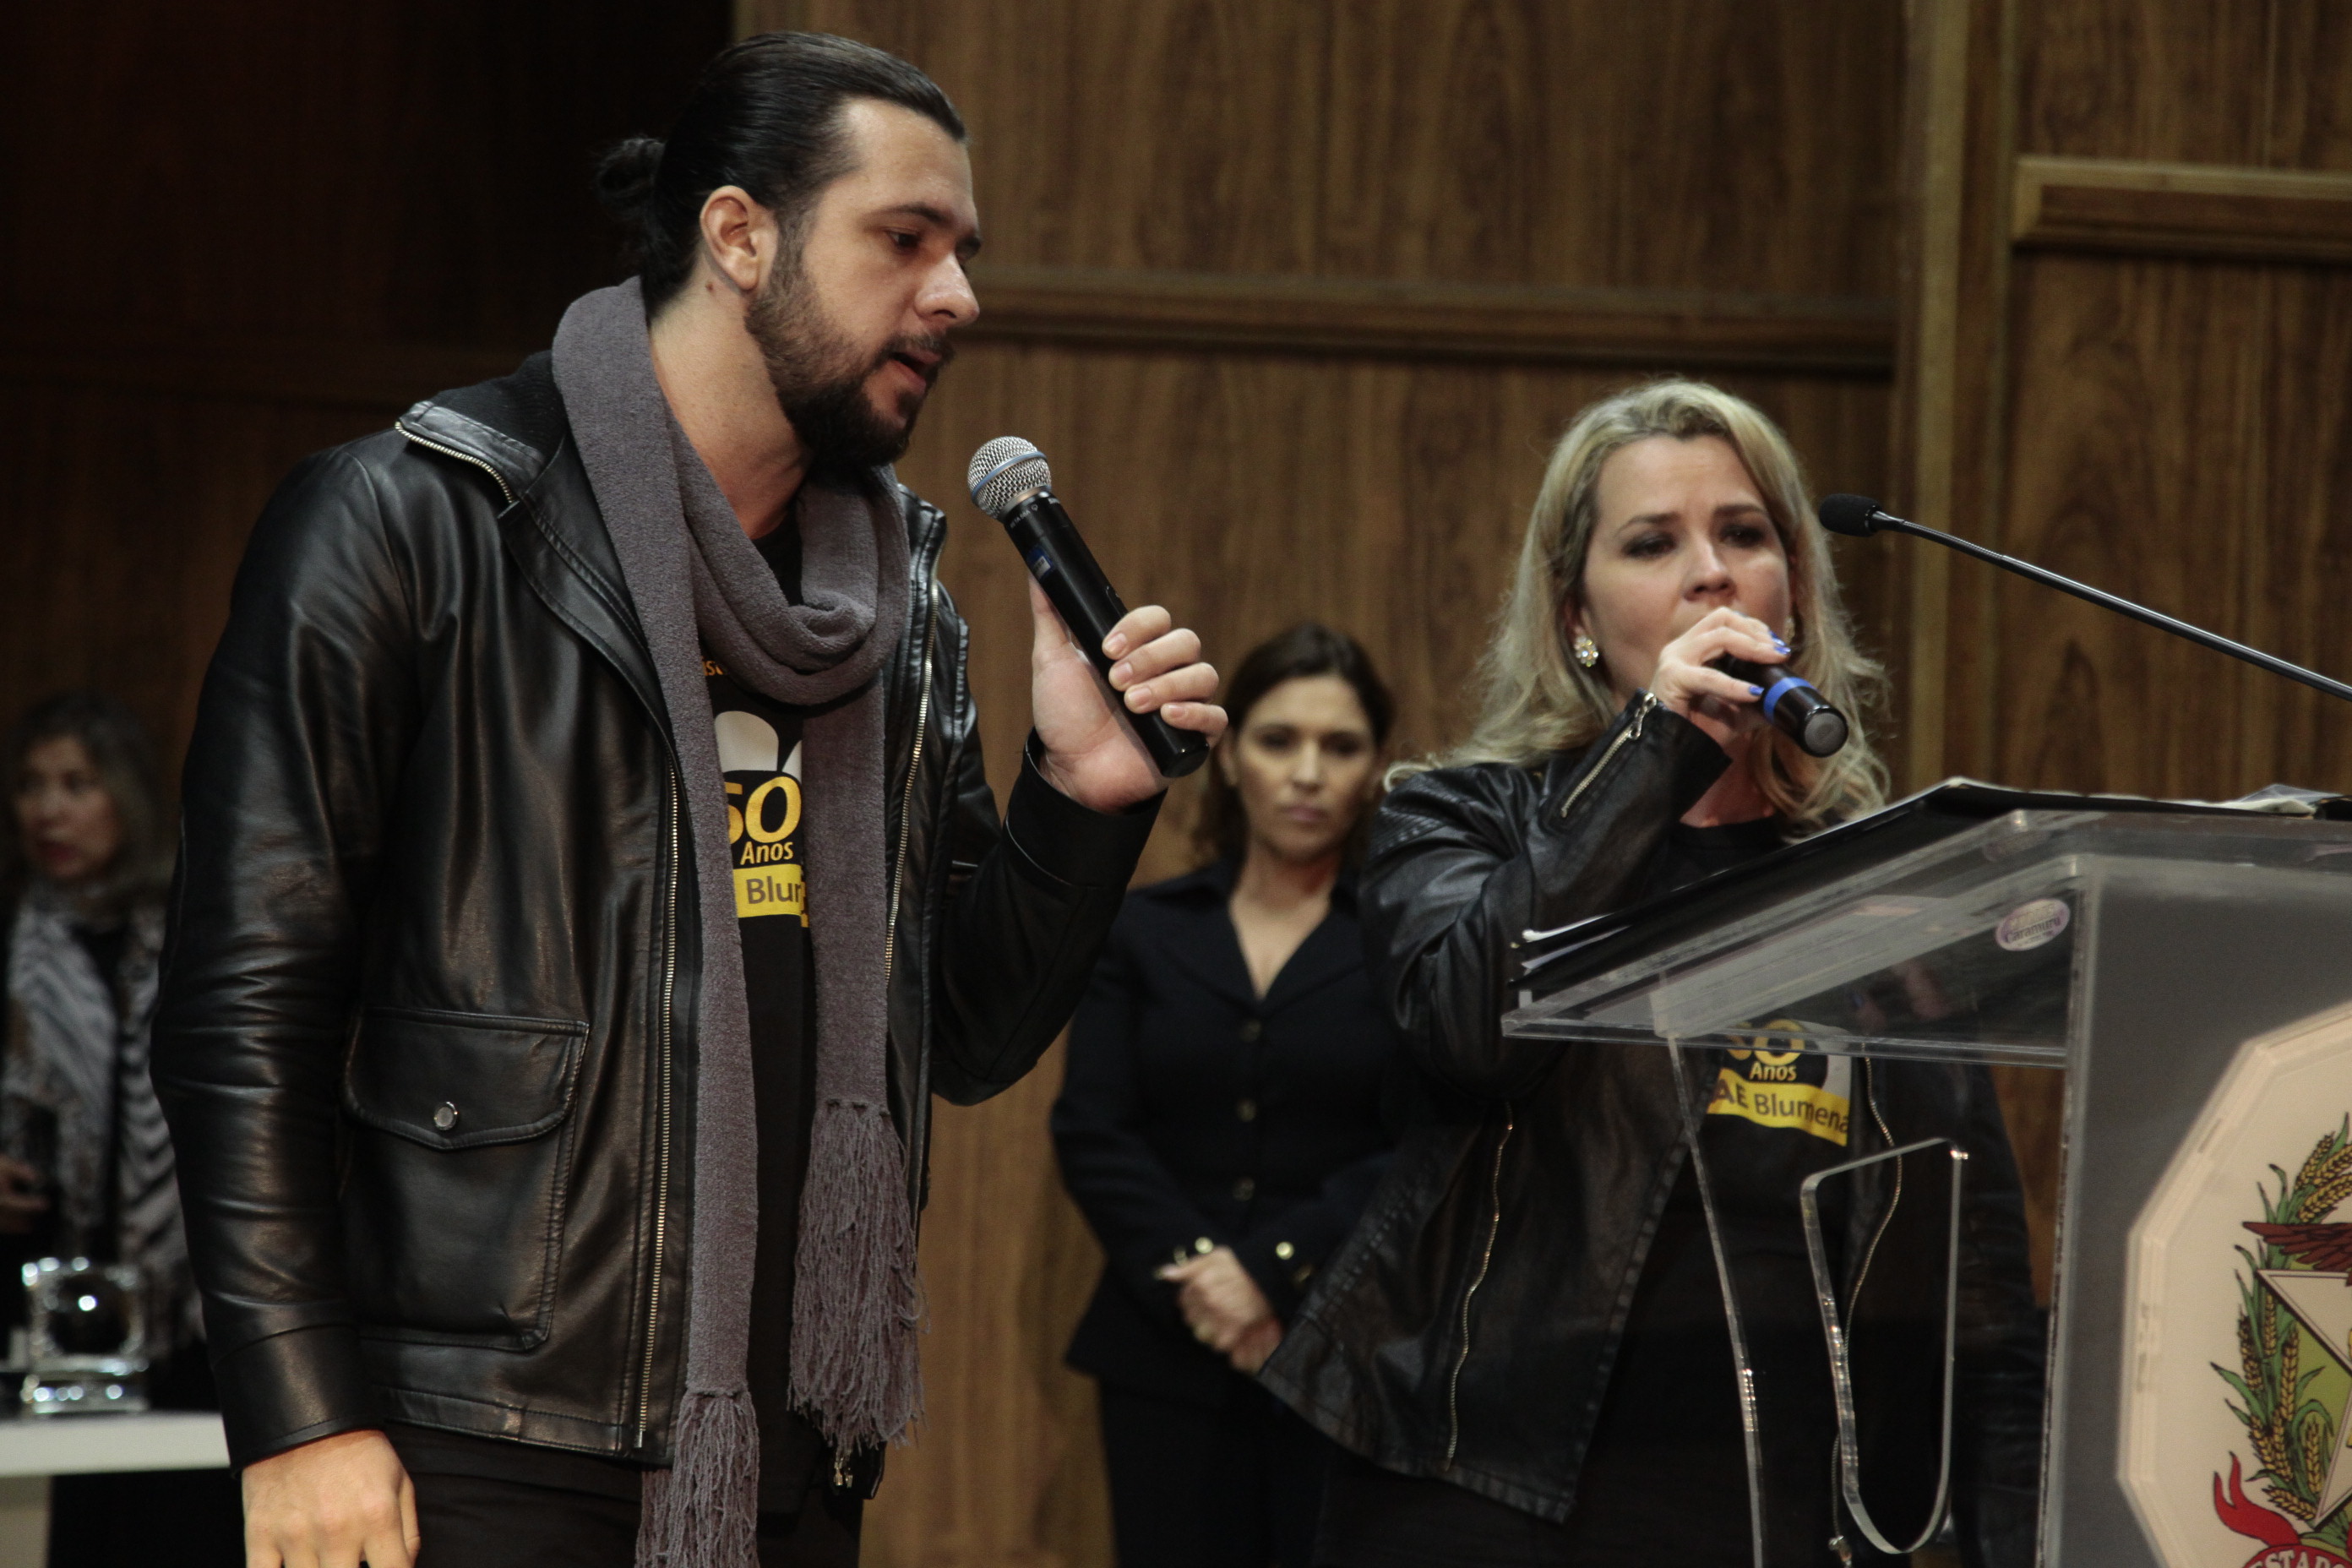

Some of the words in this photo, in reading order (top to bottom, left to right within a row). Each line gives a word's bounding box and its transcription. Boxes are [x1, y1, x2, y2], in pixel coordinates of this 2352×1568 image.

[740, 841, 793, 866] Anos
[1749, 1061, 1798, 1081] Anos
[2248, 1549, 2347, 1568] STAD
